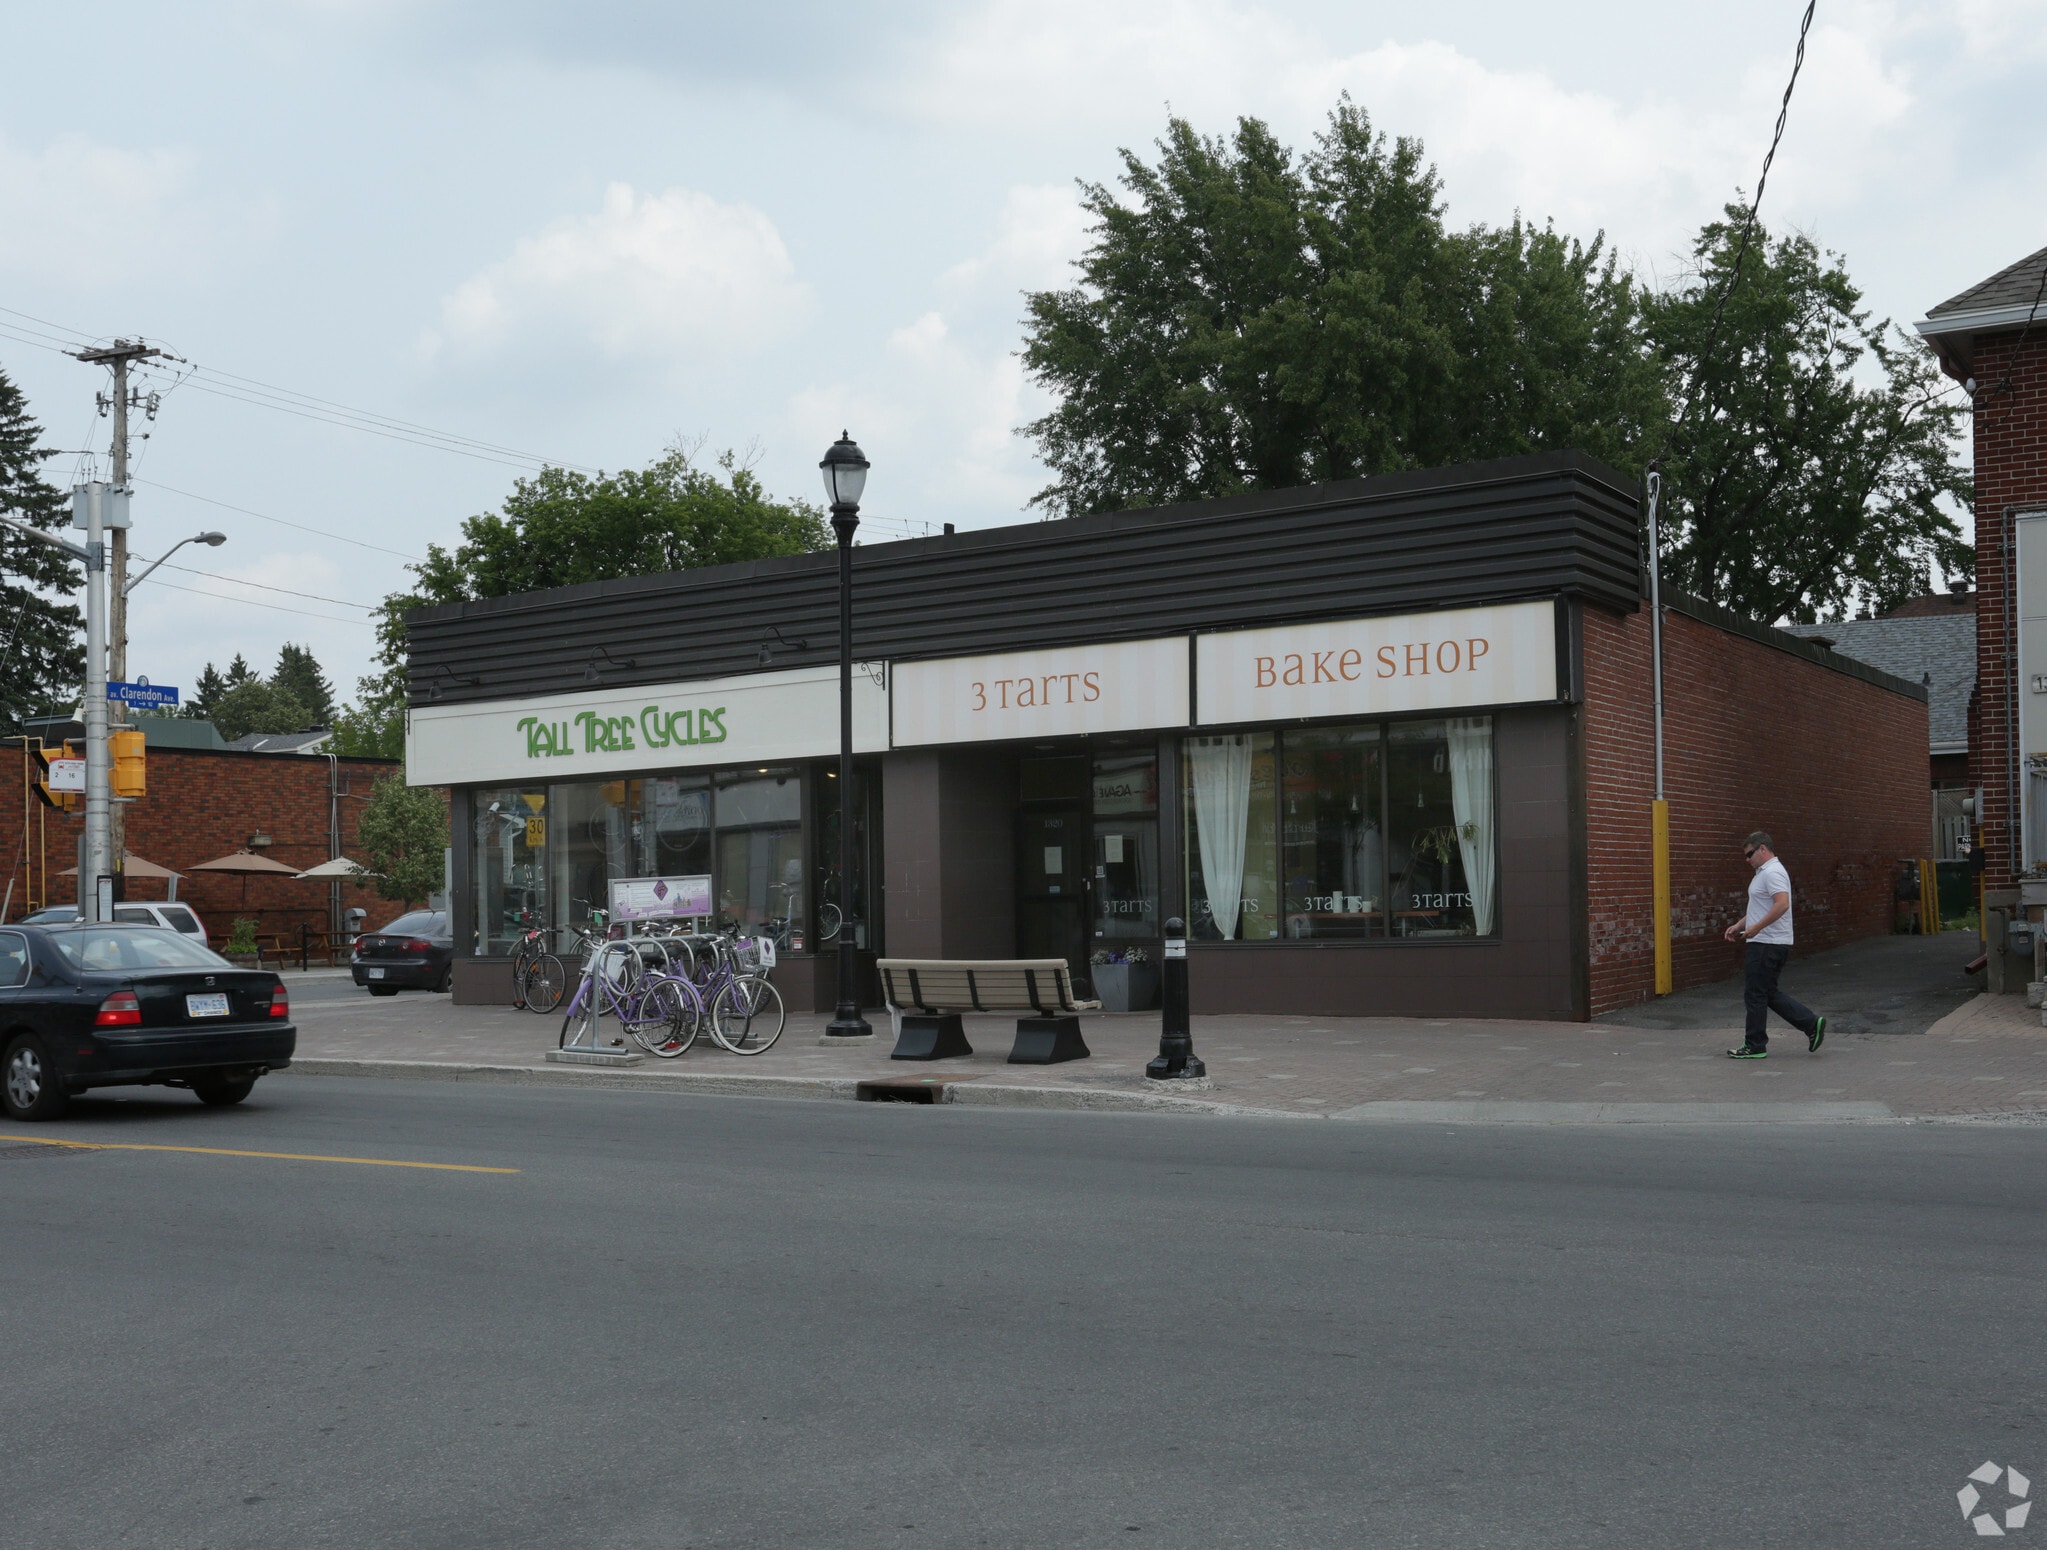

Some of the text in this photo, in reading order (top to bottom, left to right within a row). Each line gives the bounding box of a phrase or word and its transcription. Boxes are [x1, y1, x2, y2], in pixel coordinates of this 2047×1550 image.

[1376, 638, 1489, 679] SHOP
[120, 686, 162, 702] Clarendon
[163, 694, 175, 703] Ave.
[972, 682, 986, 711] 3
[529, 819, 544, 834] 30
